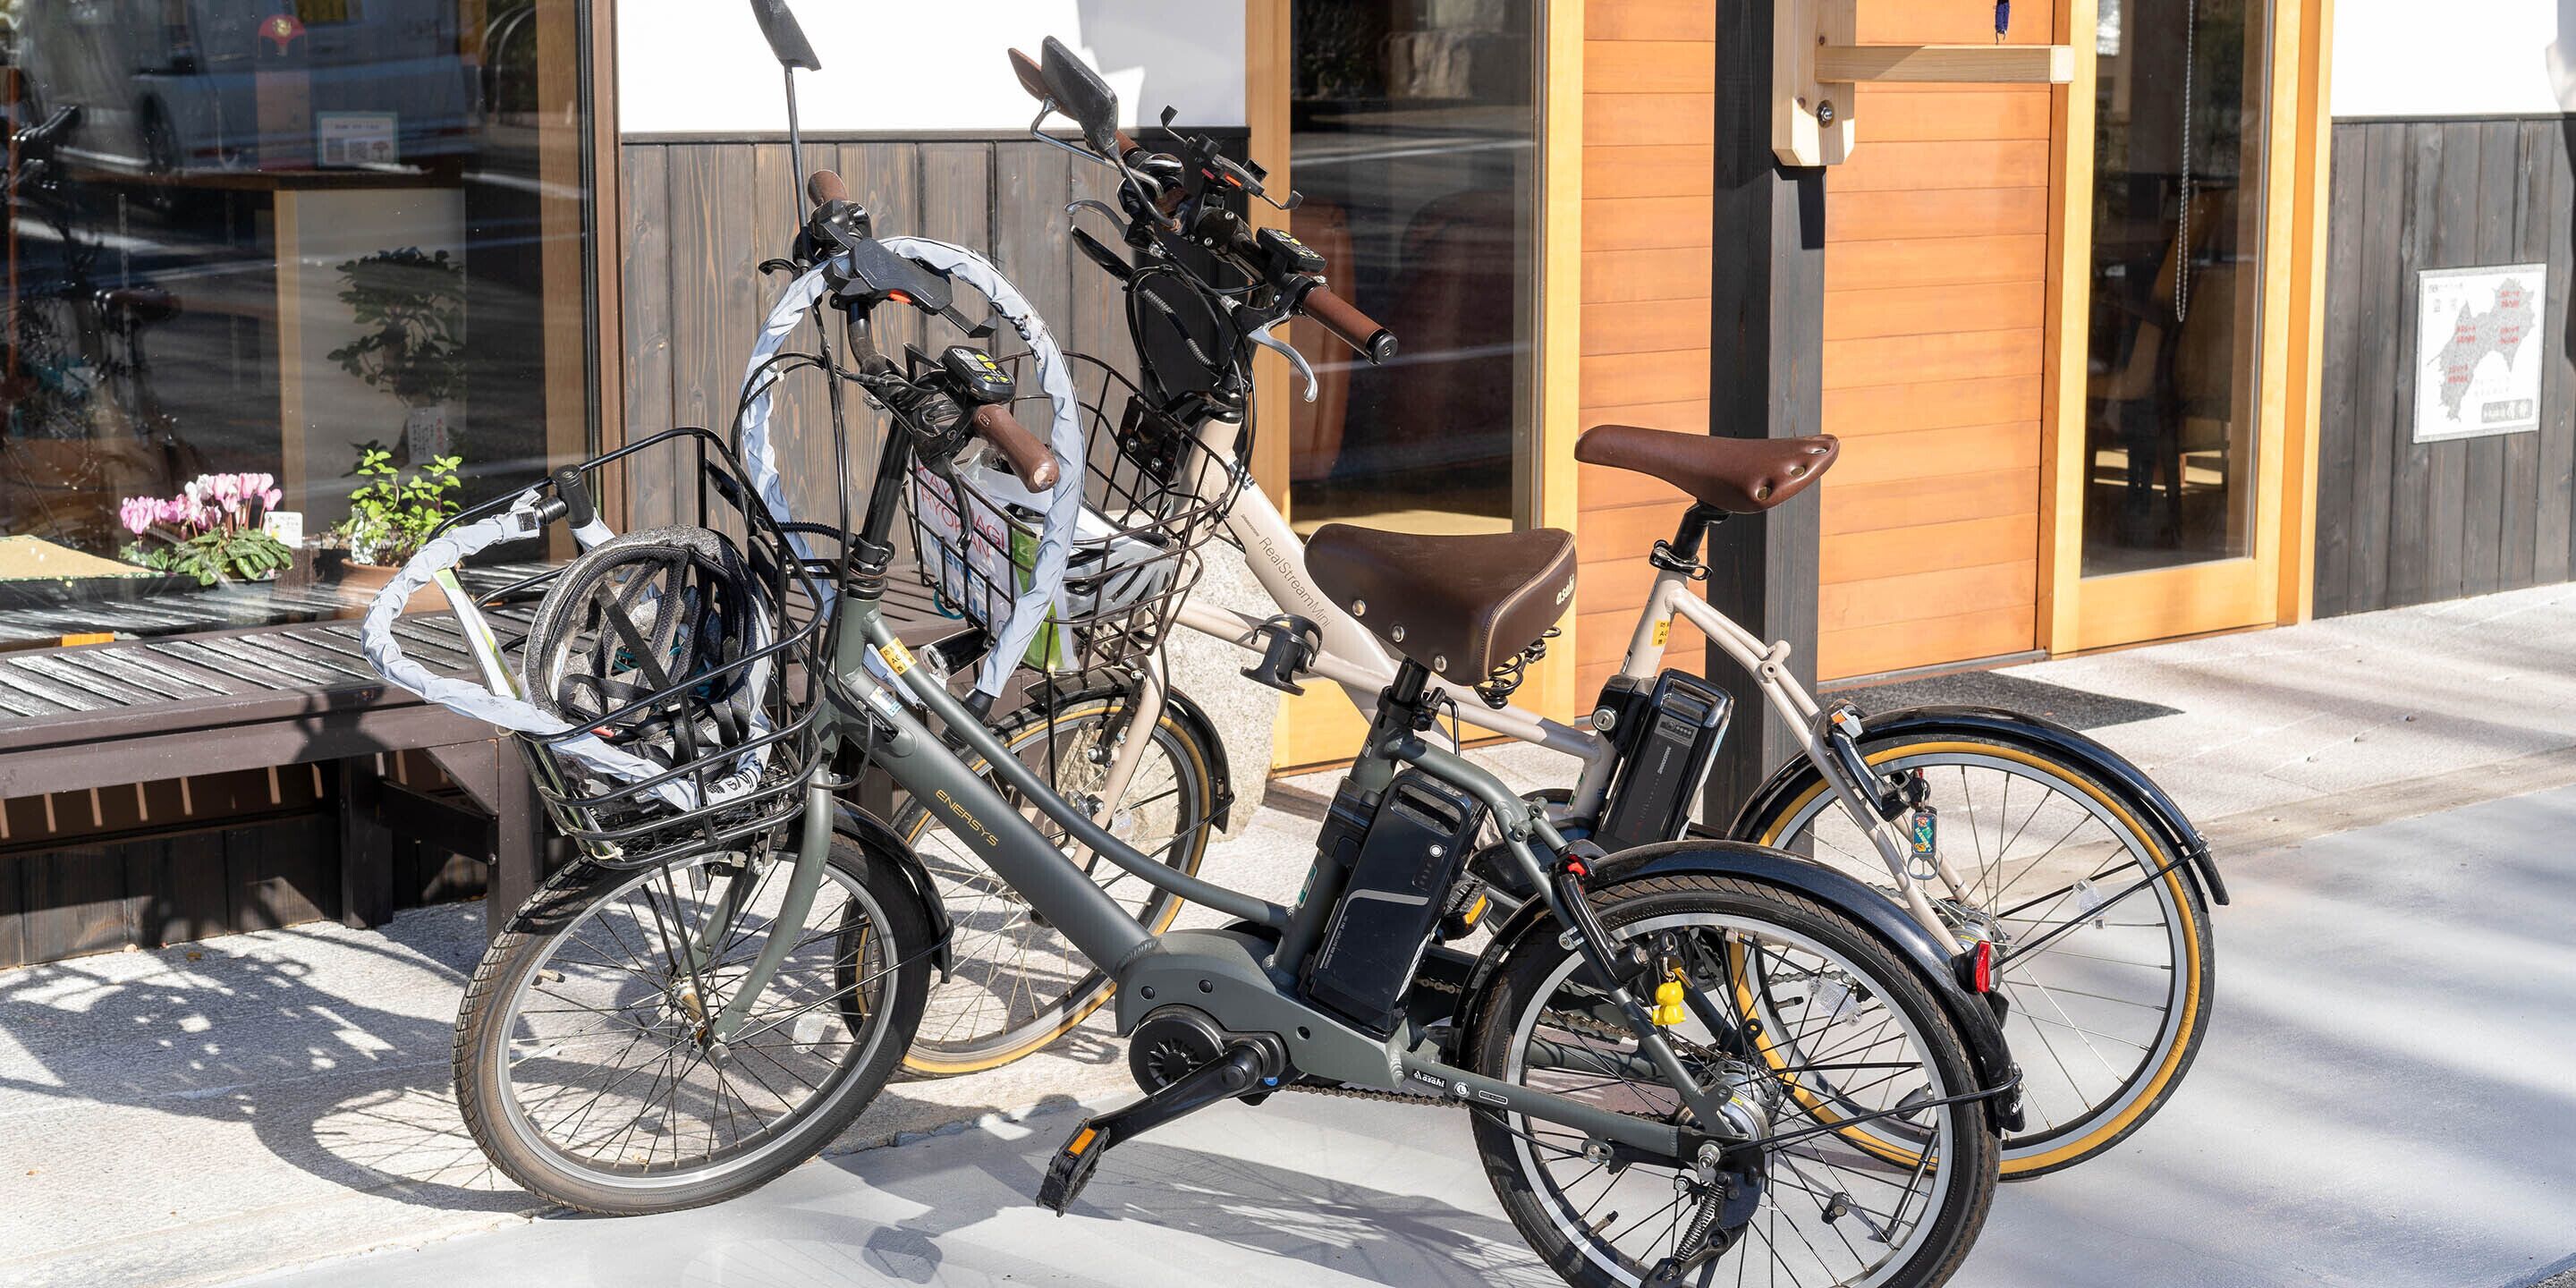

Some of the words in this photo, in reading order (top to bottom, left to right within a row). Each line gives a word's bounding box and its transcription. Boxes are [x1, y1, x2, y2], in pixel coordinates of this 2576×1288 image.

[917, 462, 1005, 550] KAYAGI
[1556, 572, 1574, 606] asahi
[936, 790, 999, 846] ENERSYS
